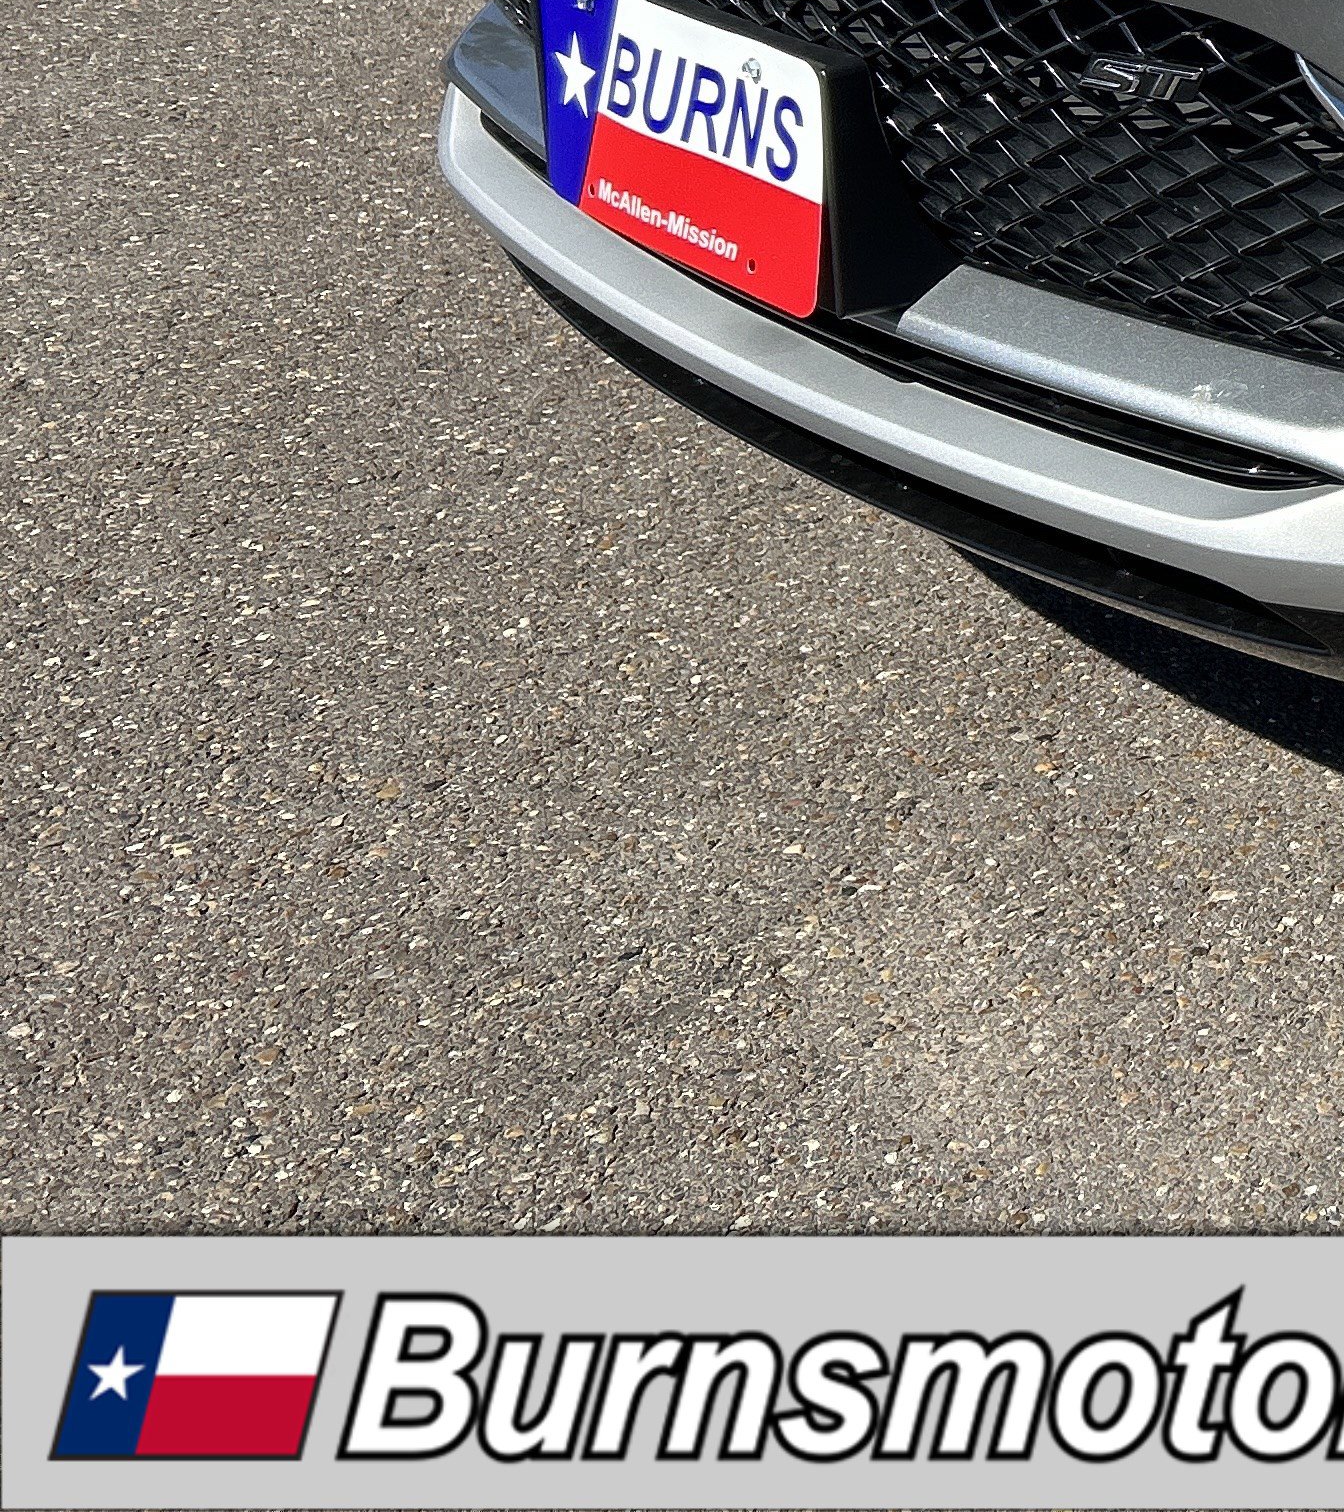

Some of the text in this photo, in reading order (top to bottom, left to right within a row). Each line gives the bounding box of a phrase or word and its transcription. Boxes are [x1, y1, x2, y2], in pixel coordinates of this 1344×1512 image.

[606, 33, 804, 183] BURNS
[1078, 57, 1203, 101] ST
[598, 177, 739, 262] McAllen-Mission
